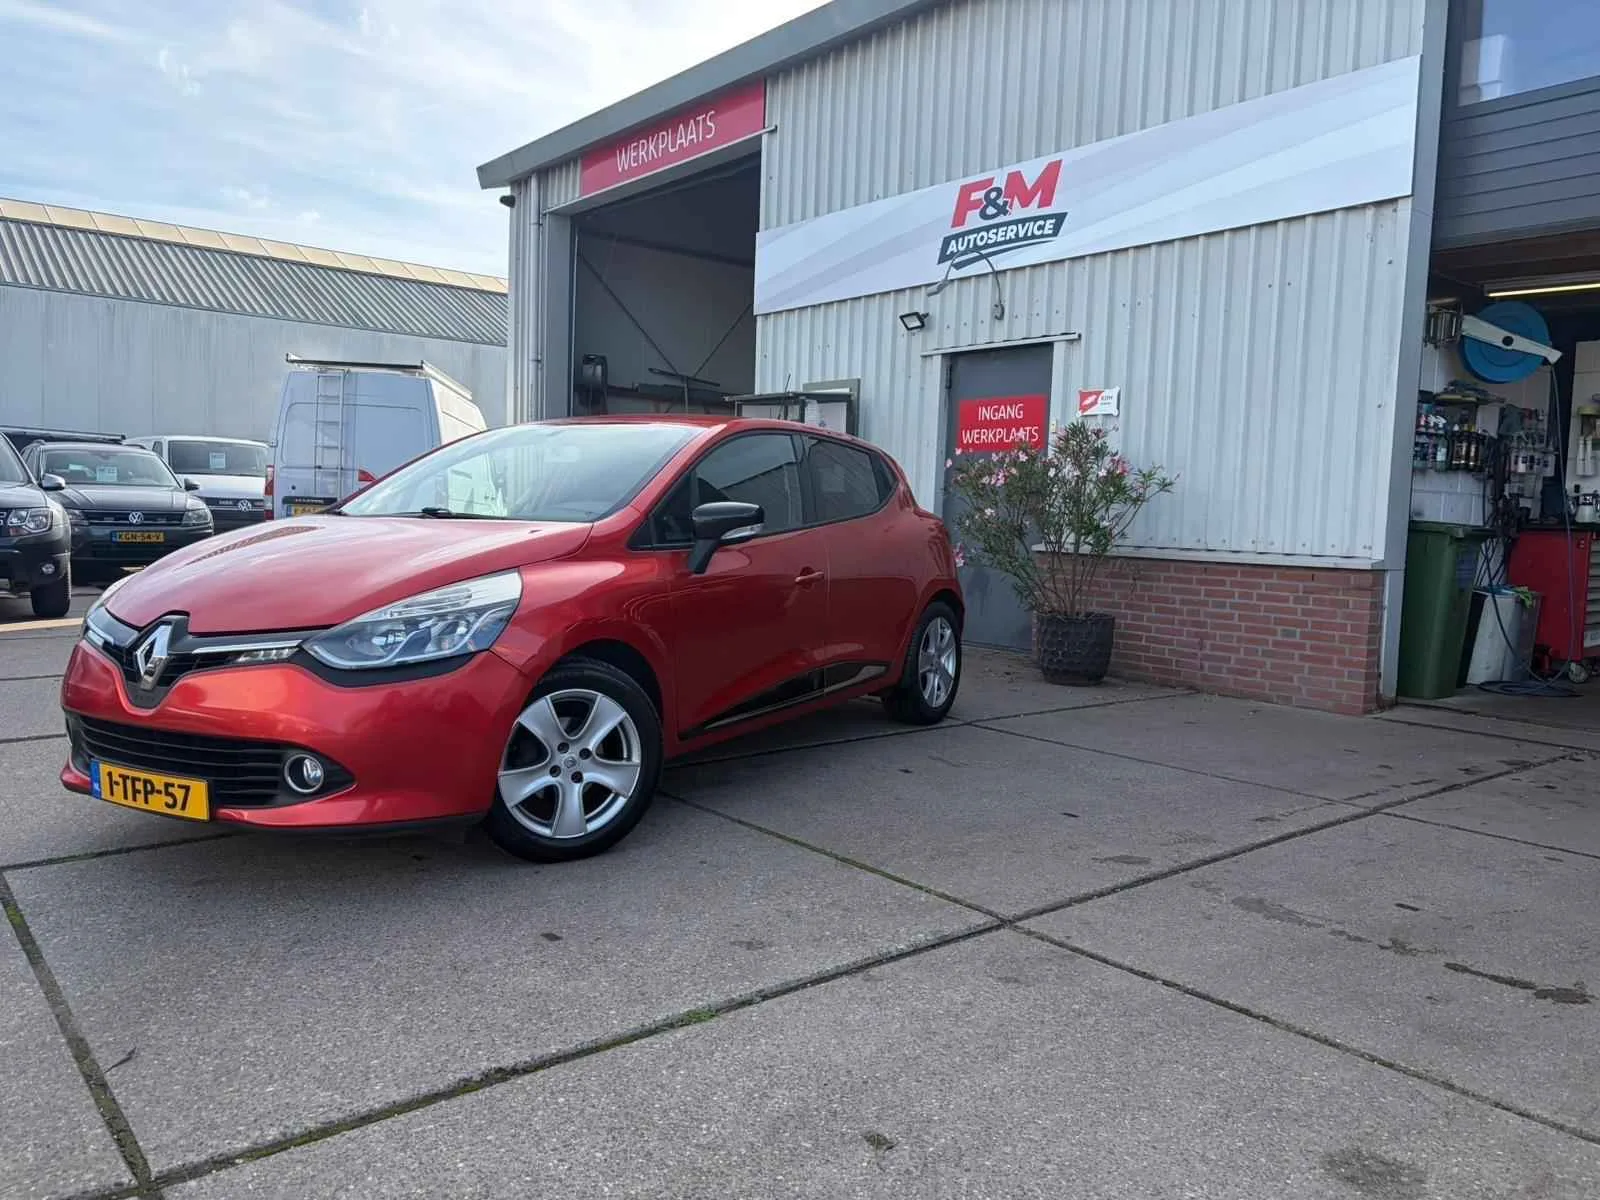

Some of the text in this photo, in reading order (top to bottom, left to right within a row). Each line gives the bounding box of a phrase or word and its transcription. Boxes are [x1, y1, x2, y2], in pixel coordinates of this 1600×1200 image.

[616, 110, 716, 173] WERKPLAATS
[950, 159, 1063, 228] F&M
[946, 219, 1056, 255] AUTOSERVICE
[978, 404, 1024, 421] INGANG
[106, 770, 191, 811] 1-TFP-57
